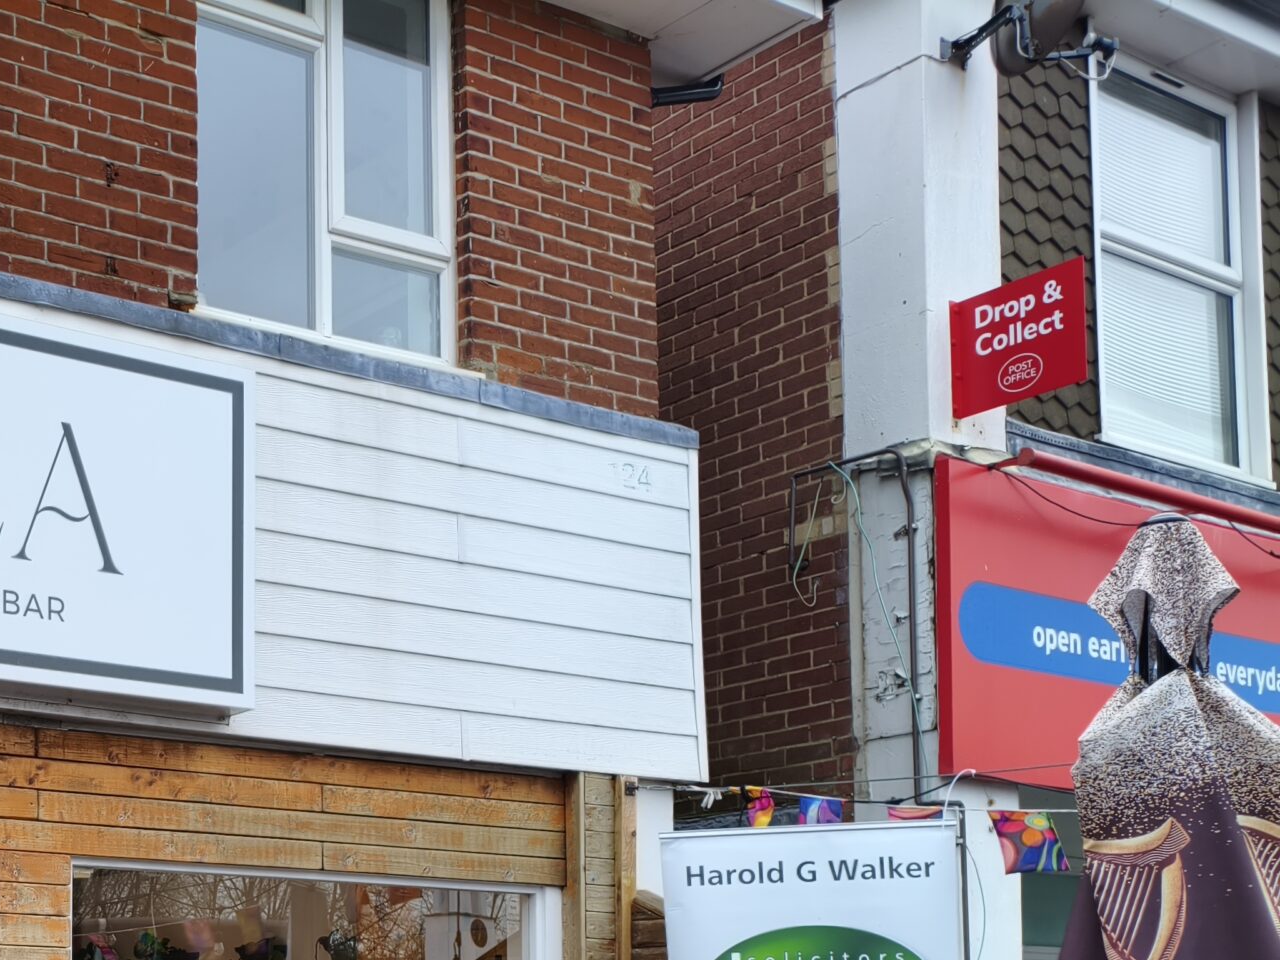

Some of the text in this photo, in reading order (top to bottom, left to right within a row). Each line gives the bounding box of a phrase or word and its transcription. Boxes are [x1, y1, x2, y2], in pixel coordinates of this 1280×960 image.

[975, 280, 1064, 329] Drop &
[975, 310, 1064, 356] Collect
[1003, 367, 1037, 386] OFFICE
[1008, 359, 1033, 374] POST
[2, 589, 66, 623] BAR
[1033, 625, 1082, 656] open
[1088, 636, 1131, 671] earl
[685, 856, 936, 887] Harold G Walker
